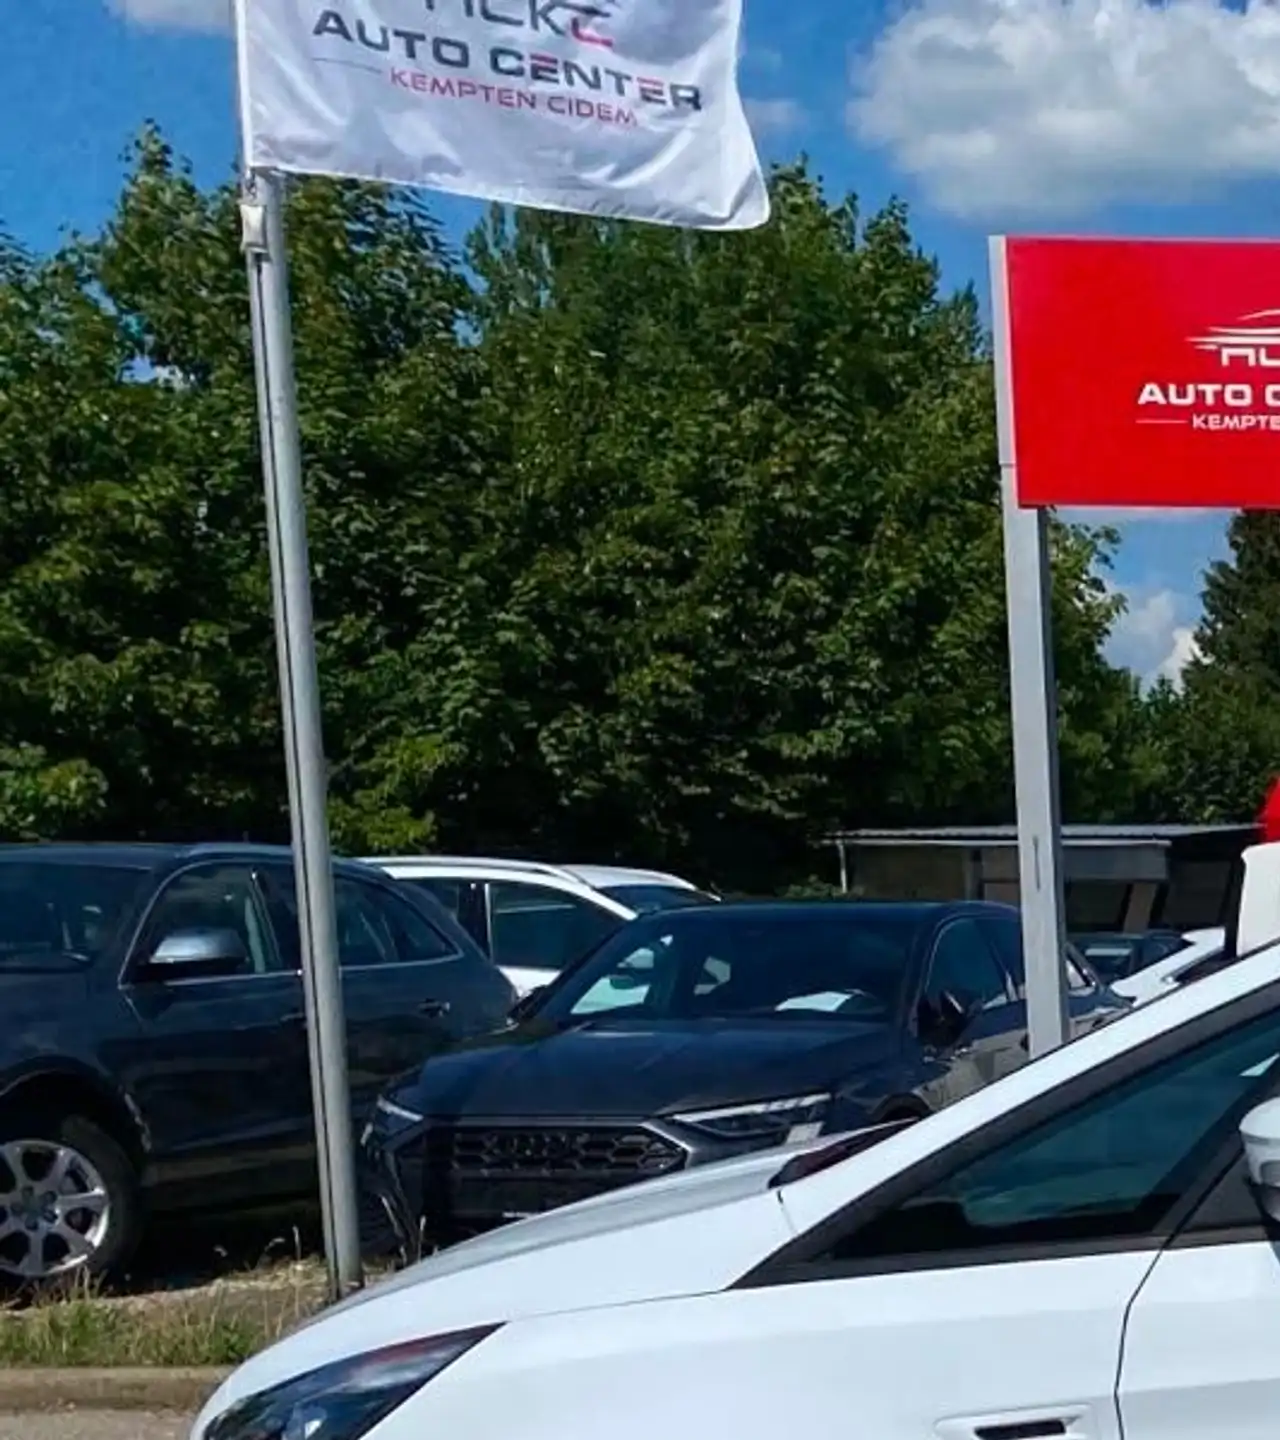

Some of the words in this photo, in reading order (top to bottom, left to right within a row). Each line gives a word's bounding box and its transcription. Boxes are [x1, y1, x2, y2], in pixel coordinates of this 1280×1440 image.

[312, 9, 470, 68] AUTO
[489, 47, 702, 110] CENTER
[389, 66, 537, 110] KEMPTEN
[546, 94, 638, 127] CIDEM
[1137, 382, 1253, 406] AUTO
